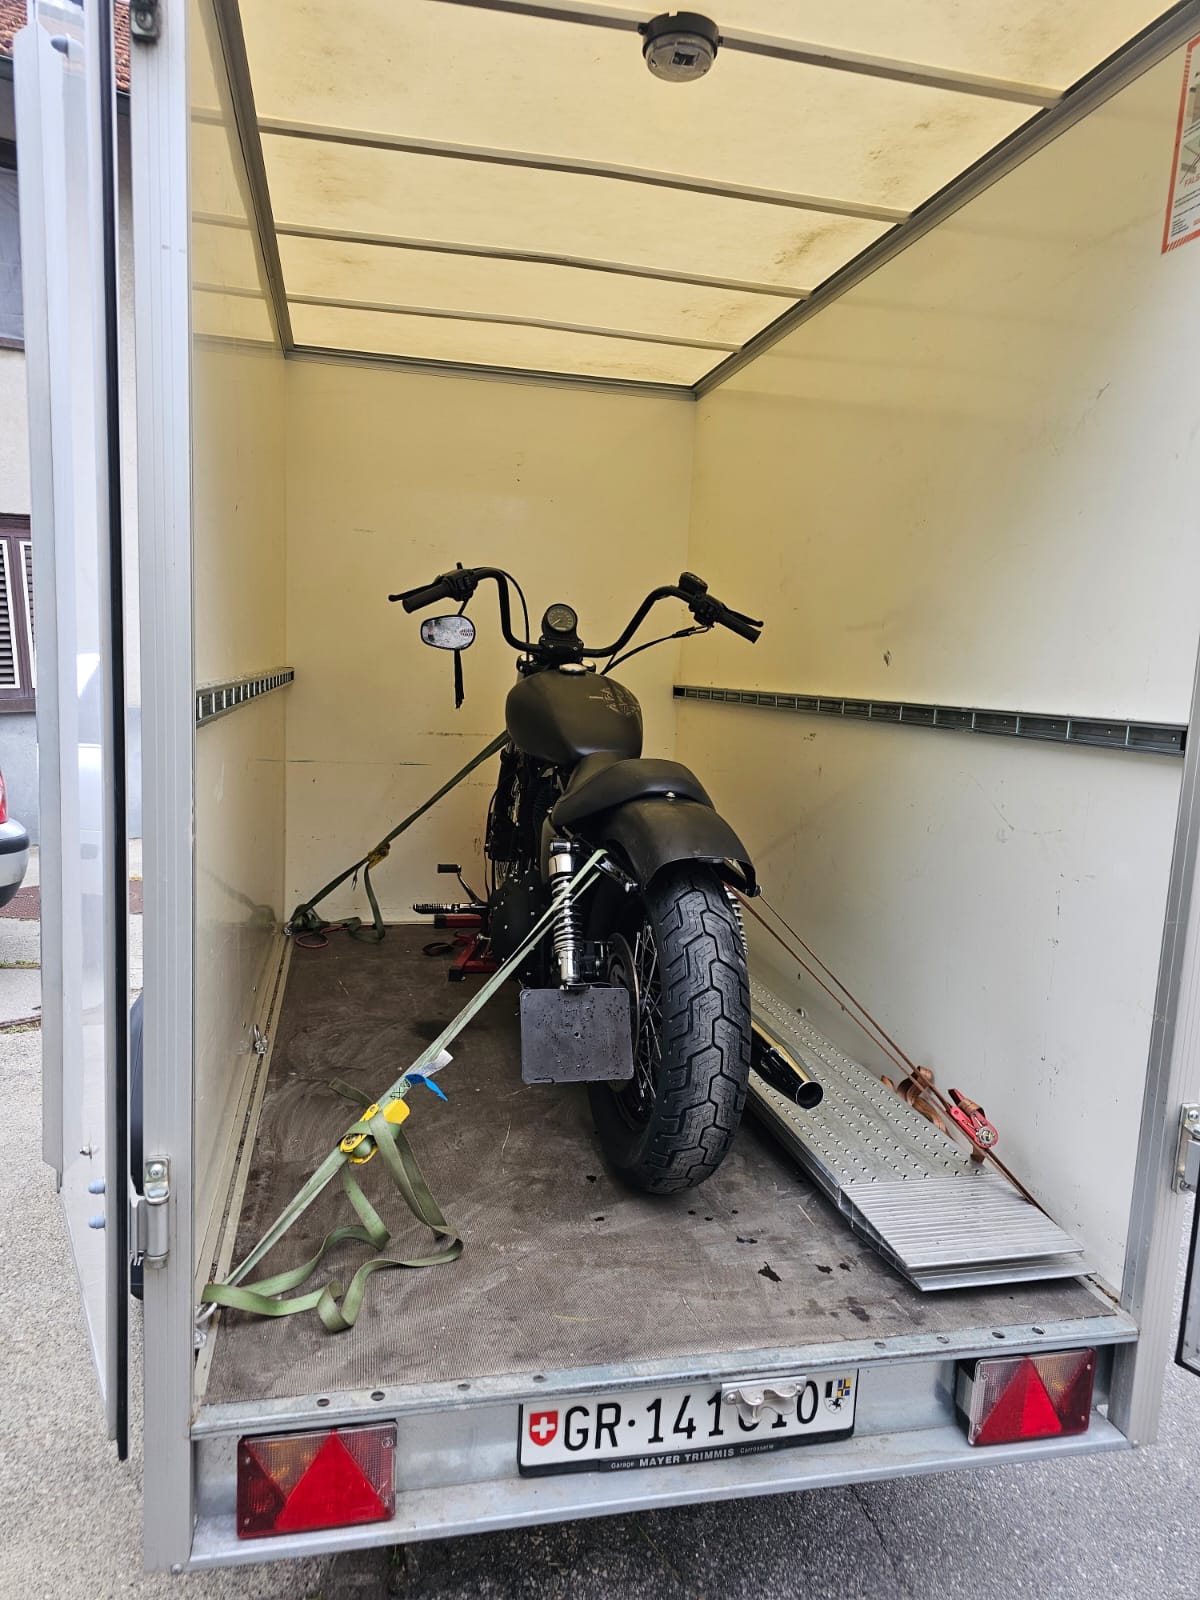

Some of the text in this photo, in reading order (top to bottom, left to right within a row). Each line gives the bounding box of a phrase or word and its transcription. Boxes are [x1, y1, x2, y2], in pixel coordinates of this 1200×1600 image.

[611, 1461, 635, 1469] Garage
[639, 1455, 681, 1467] MAYER
[685, 1448, 735, 1462] TRIMMIS
